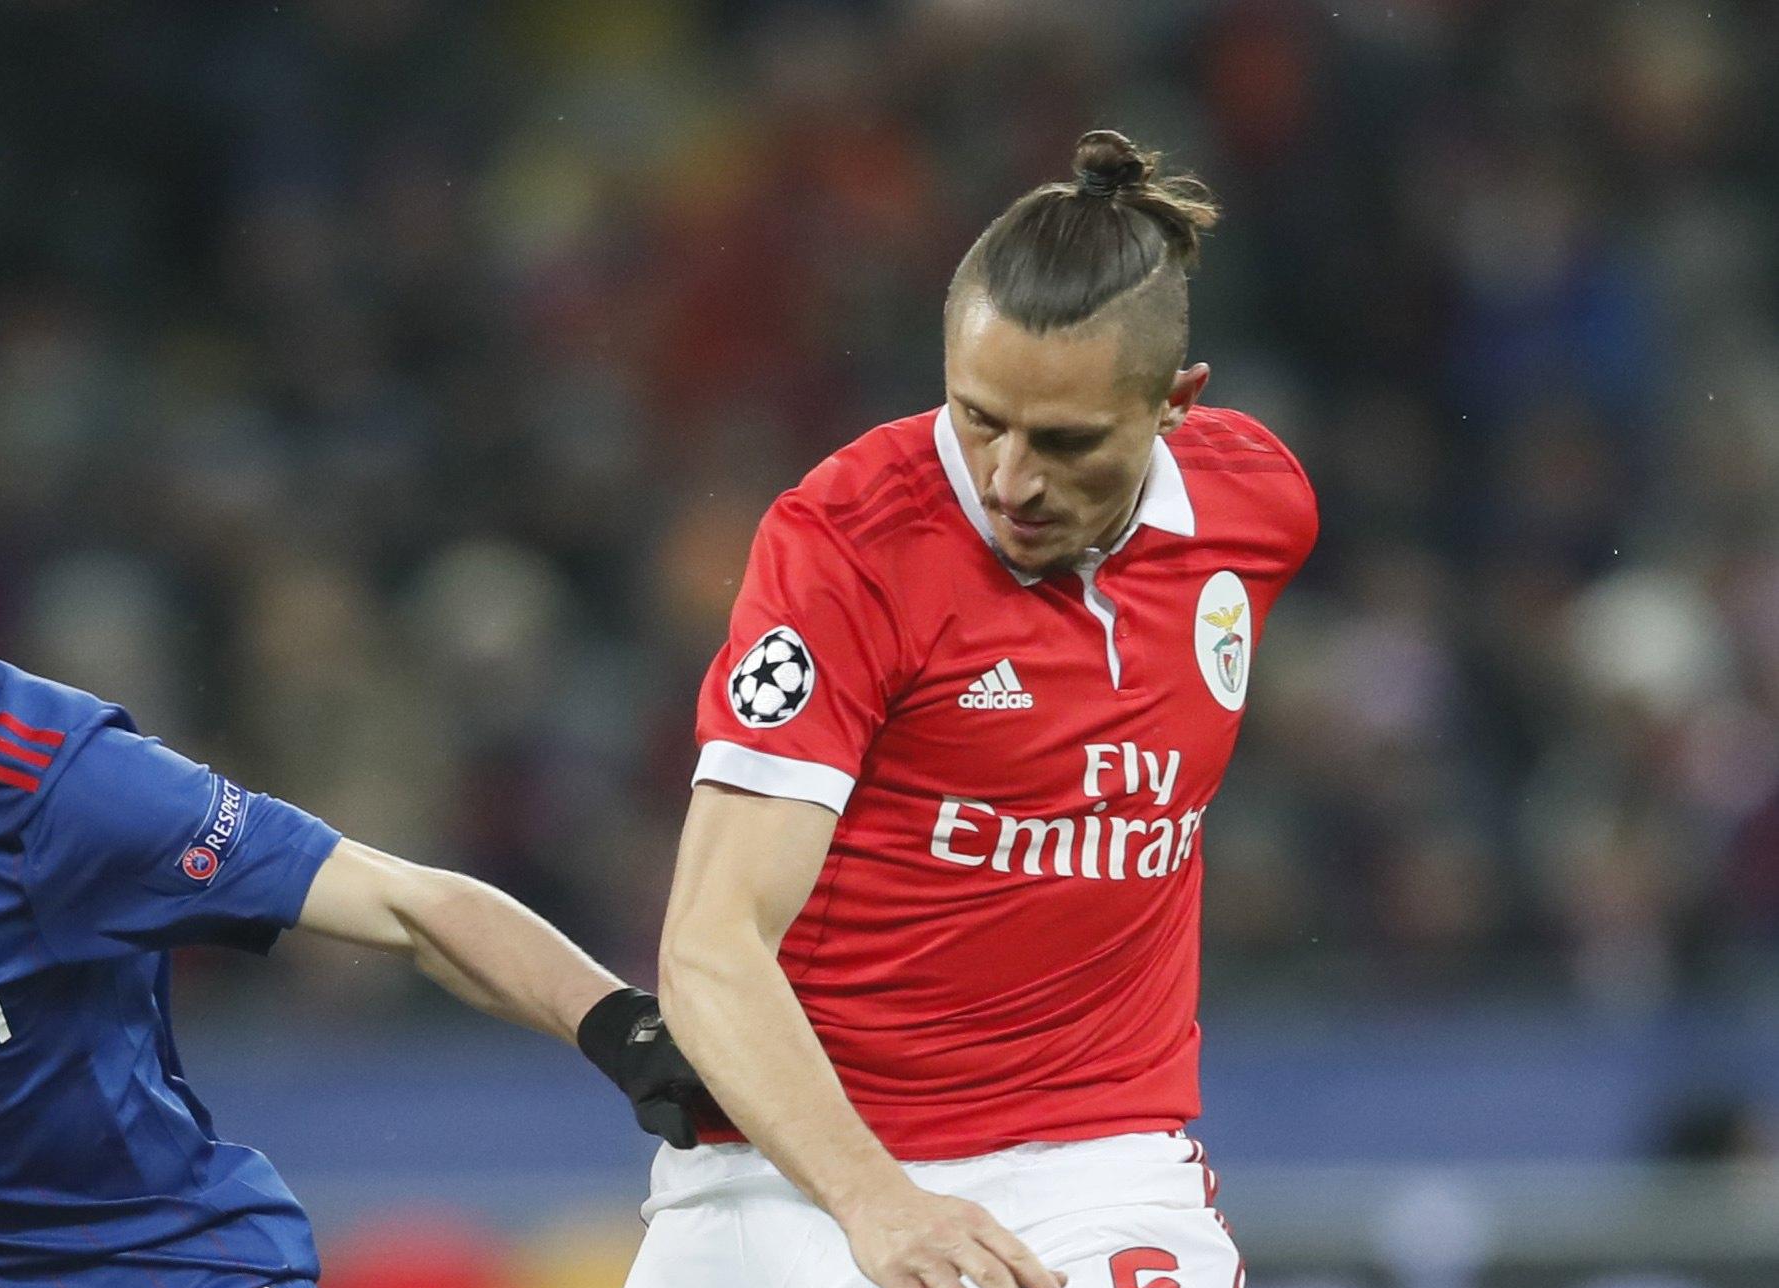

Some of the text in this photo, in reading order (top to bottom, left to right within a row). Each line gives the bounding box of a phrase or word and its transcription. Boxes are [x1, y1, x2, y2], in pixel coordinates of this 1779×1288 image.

[958, 689, 1034, 710] adidas
[1083, 741, 1181, 806] Fly
[204, 779, 241, 851] RESPECT
[930, 794, 1207, 881] Emirat
